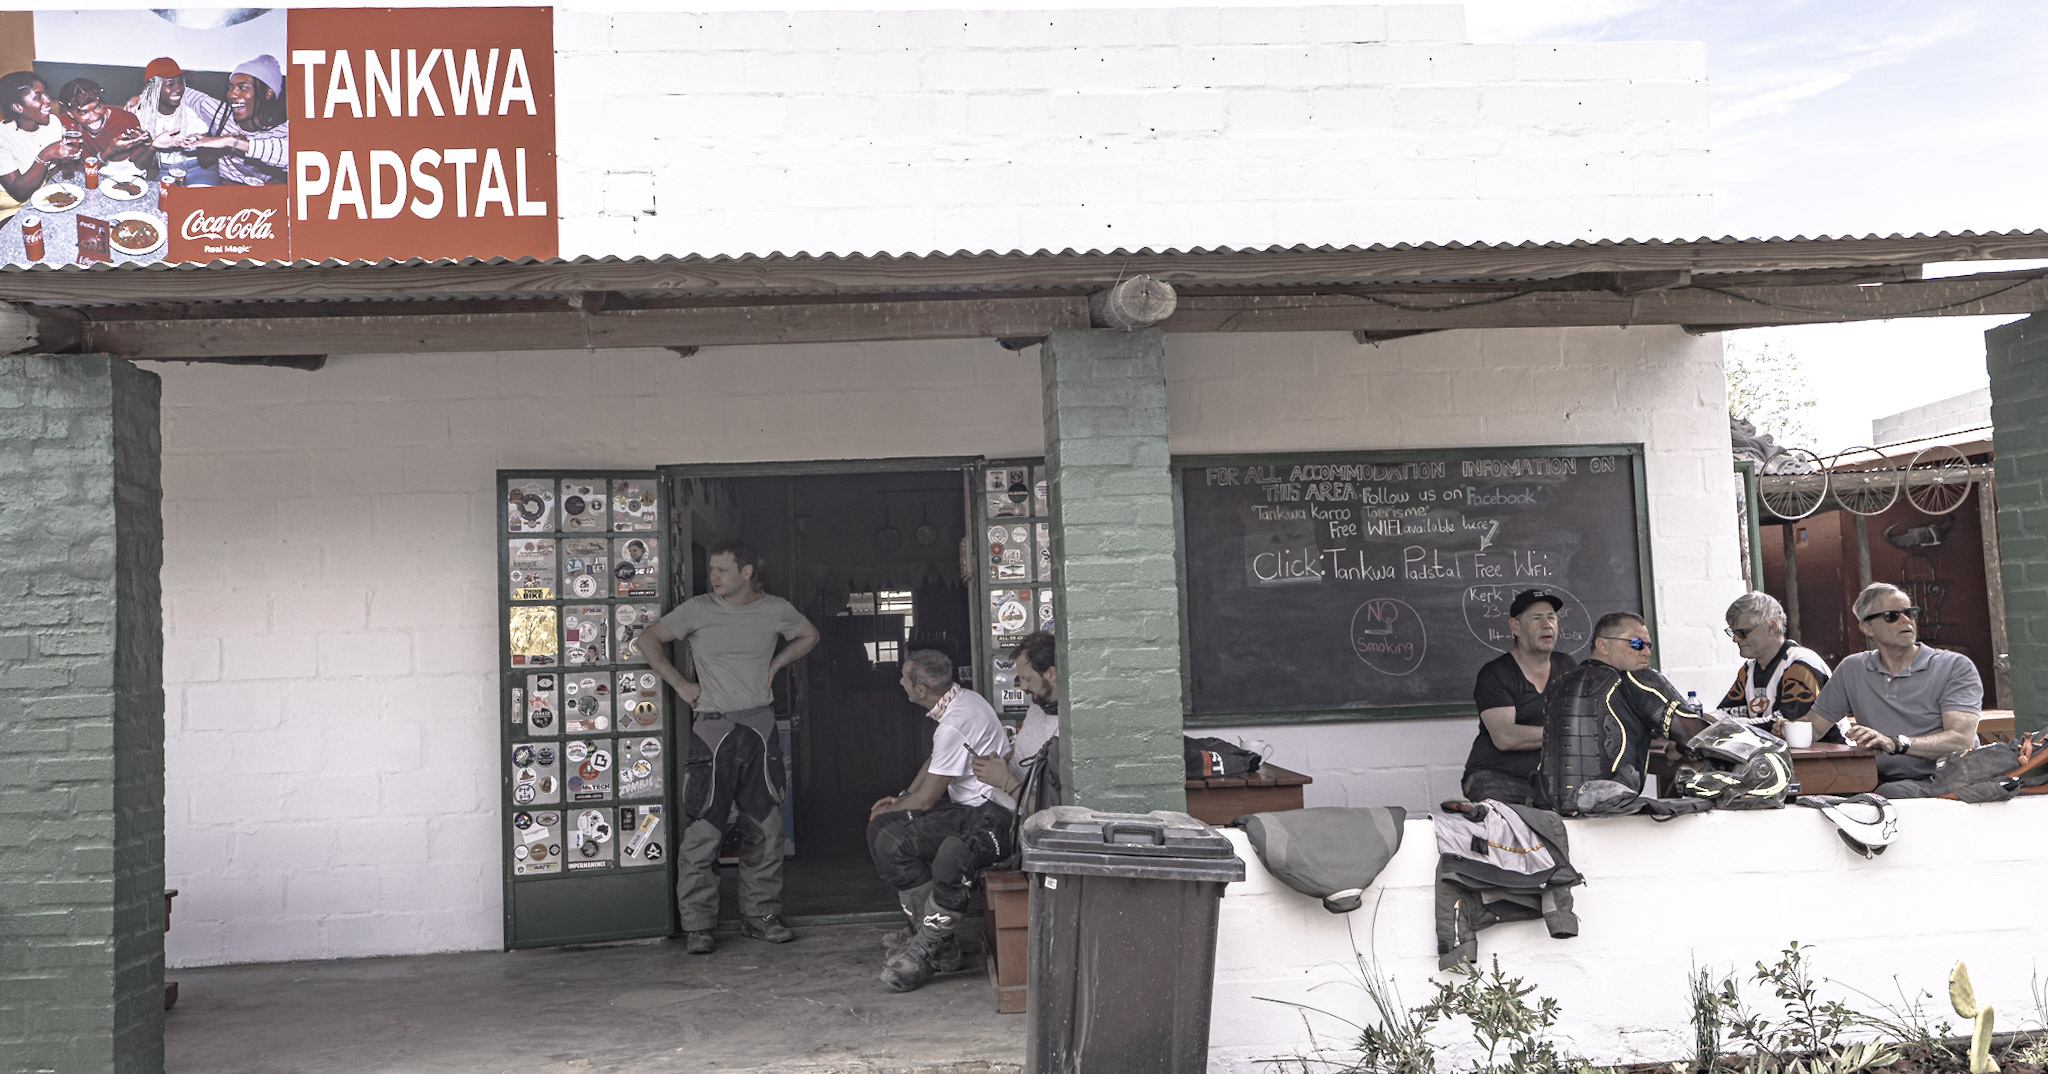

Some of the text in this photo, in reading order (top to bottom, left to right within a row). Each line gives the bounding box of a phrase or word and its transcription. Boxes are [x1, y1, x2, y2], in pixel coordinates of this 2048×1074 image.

[292, 48, 537, 118] TANKWA
[296, 147, 548, 220] PADSTAL
[181, 208, 277, 240] Coca-Cola
[204, 244, 250, 254] Real Magic
[1206, 456, 1615, 486] FOR ALL ACCOMMODATION INFOMATION ON
[1262, 482, 1300, 502] THIS
[1362, 487, 1409, 505] Follow
[1419, 490, 1437, 501] us
[1443, 489, 1462, 500] on
[1329, 514, 1488, 539] Free WIFI available here
[1253, 547, 1326, 581] Click:
[1323, 547, 1396, 581] Tankwa
[1403, 545, 1461, 580] Padstal
[1474, 553, 1503, 578] Free
[1469, 585, 1503, 604] Kerk
[1368, 600, 1398, 623] NO
[1357, 637, 1414, 661] Smoking
[1003, 689, 1022, 699] Zulu
[567, 861, 606, 870] IMPERMANENCE
